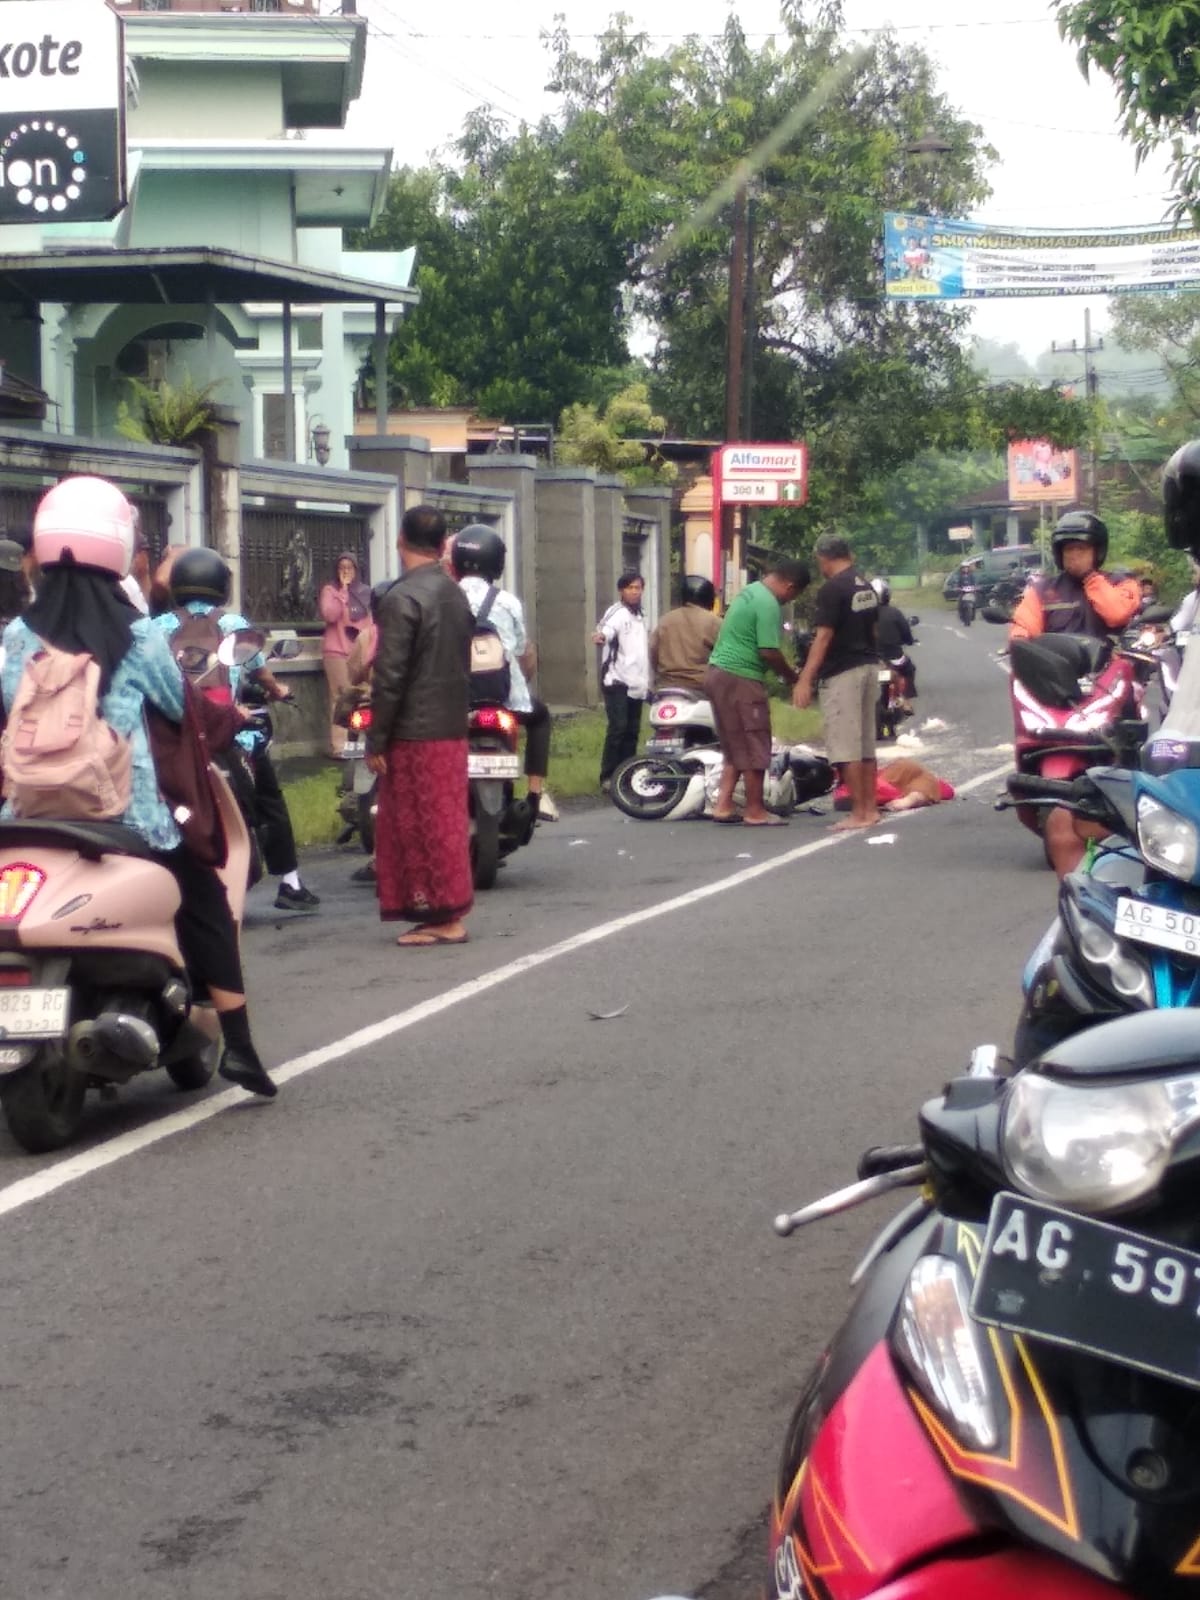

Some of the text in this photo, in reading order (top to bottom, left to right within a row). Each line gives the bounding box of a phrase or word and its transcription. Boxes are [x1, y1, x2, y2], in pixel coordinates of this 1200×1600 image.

[932, 234, 968, 247] SMK
[972, 233, 1120, 250] MUHAMMADIYAH
[1139, 229, 1200, 245] TULUN
[730, 452, 798, 467] Alfamart
[733, 485, 766, 496] 300 M
[1122, 903, 1200, 936] AG 50
[992, 1208, 1200, 1318] AG 59
